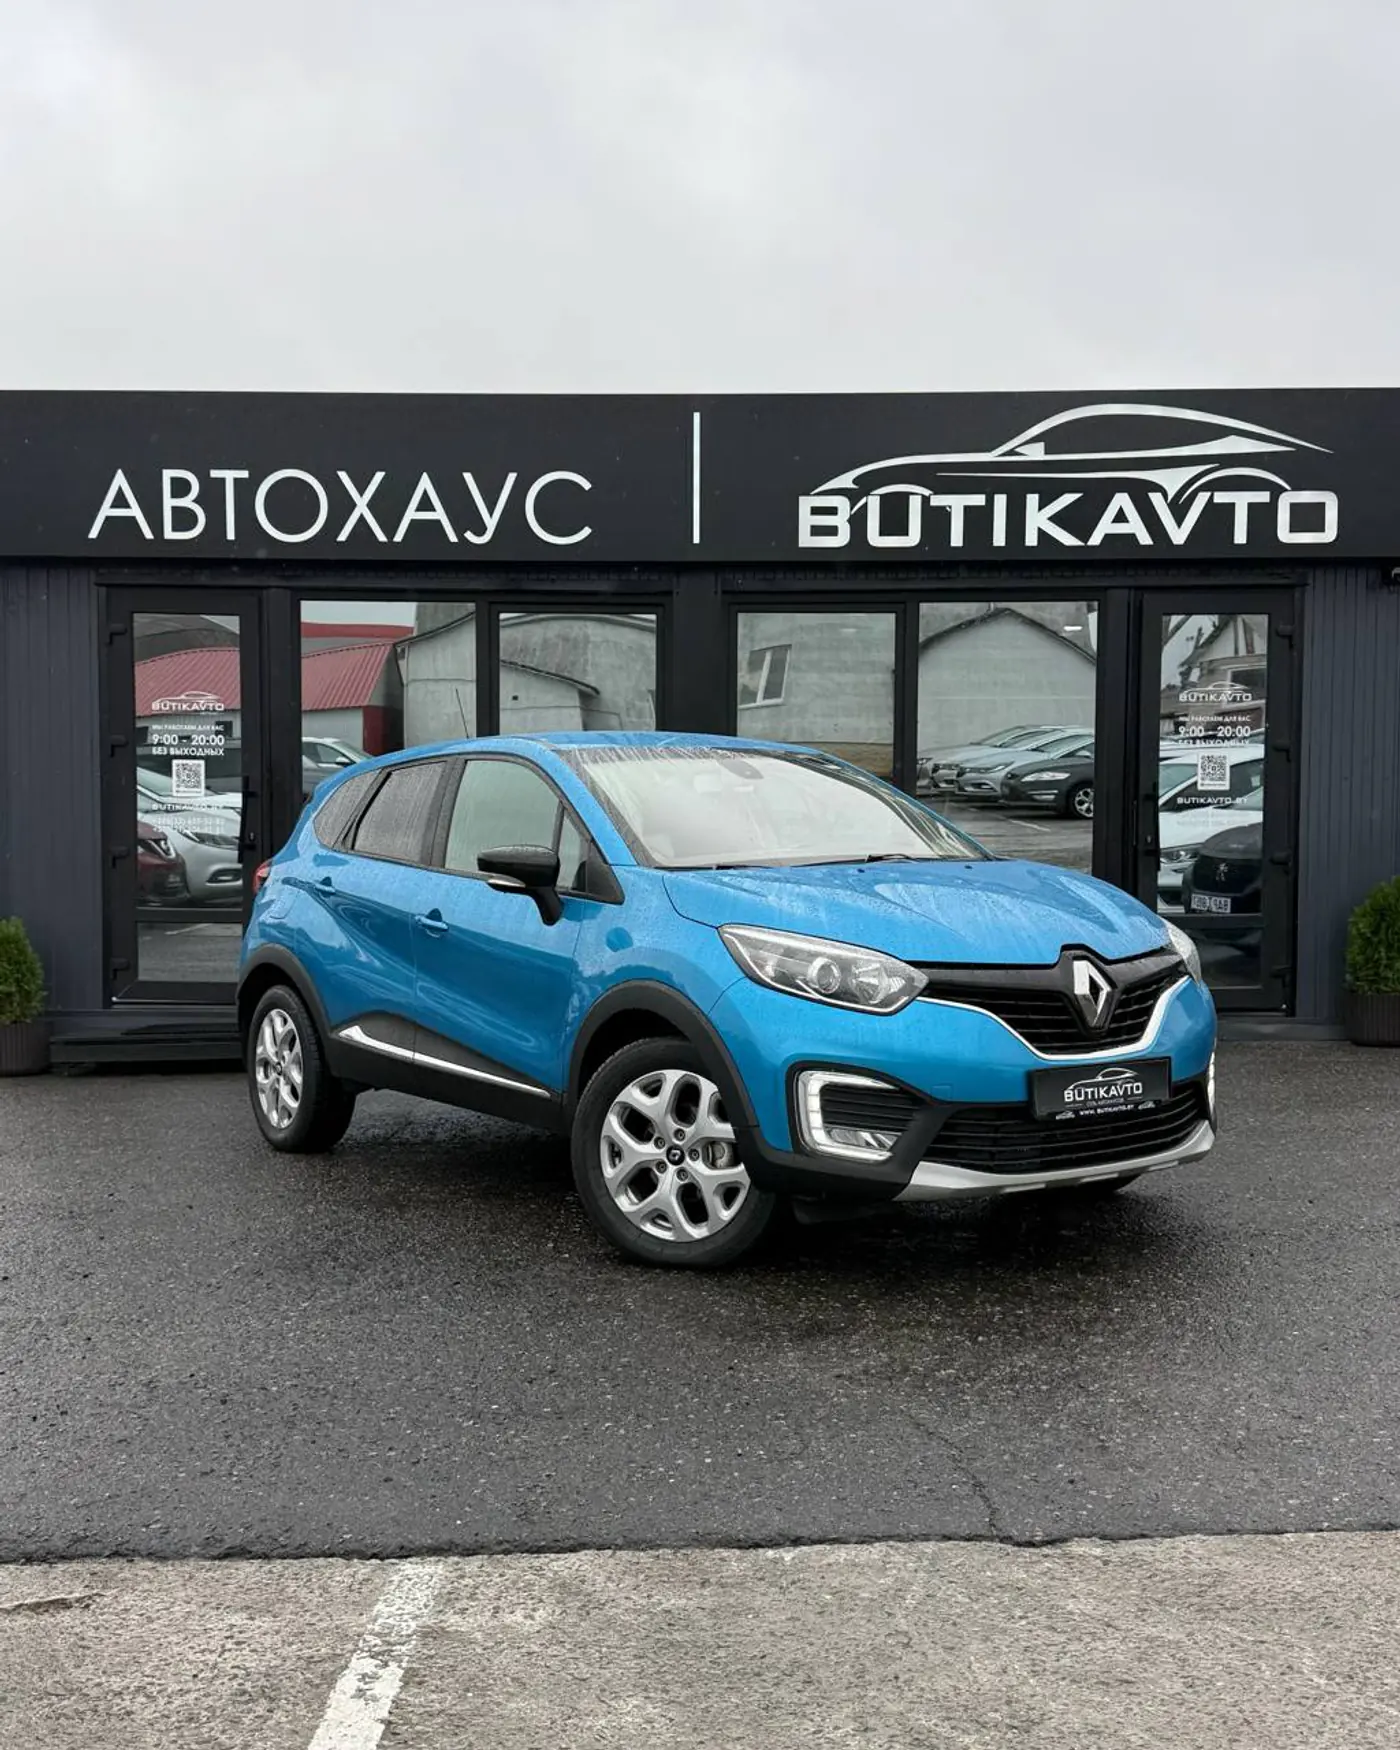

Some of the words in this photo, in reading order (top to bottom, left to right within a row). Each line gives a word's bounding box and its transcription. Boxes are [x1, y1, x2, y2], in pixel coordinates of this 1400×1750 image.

[88, 468, 593, 545] АВТОХАУС
[798, 489, 1338, 547] BUTIKAVTO
[1179, 692, 1252, 701] BUTIKAVTO
[152, 702, 225, 711] BUTIKAVTO
[1179, 726, 1204, 737] 9:00
[1217, 726, 1251, 737] 20:00
[152, 734, 179, 745] 9:00
[191, 734, 225, 746] 20:00
[169, 747, 225, 756] ВЫХОДНЫХ
[1063, 1082, 1143, 1101] BUTIKAVTO
